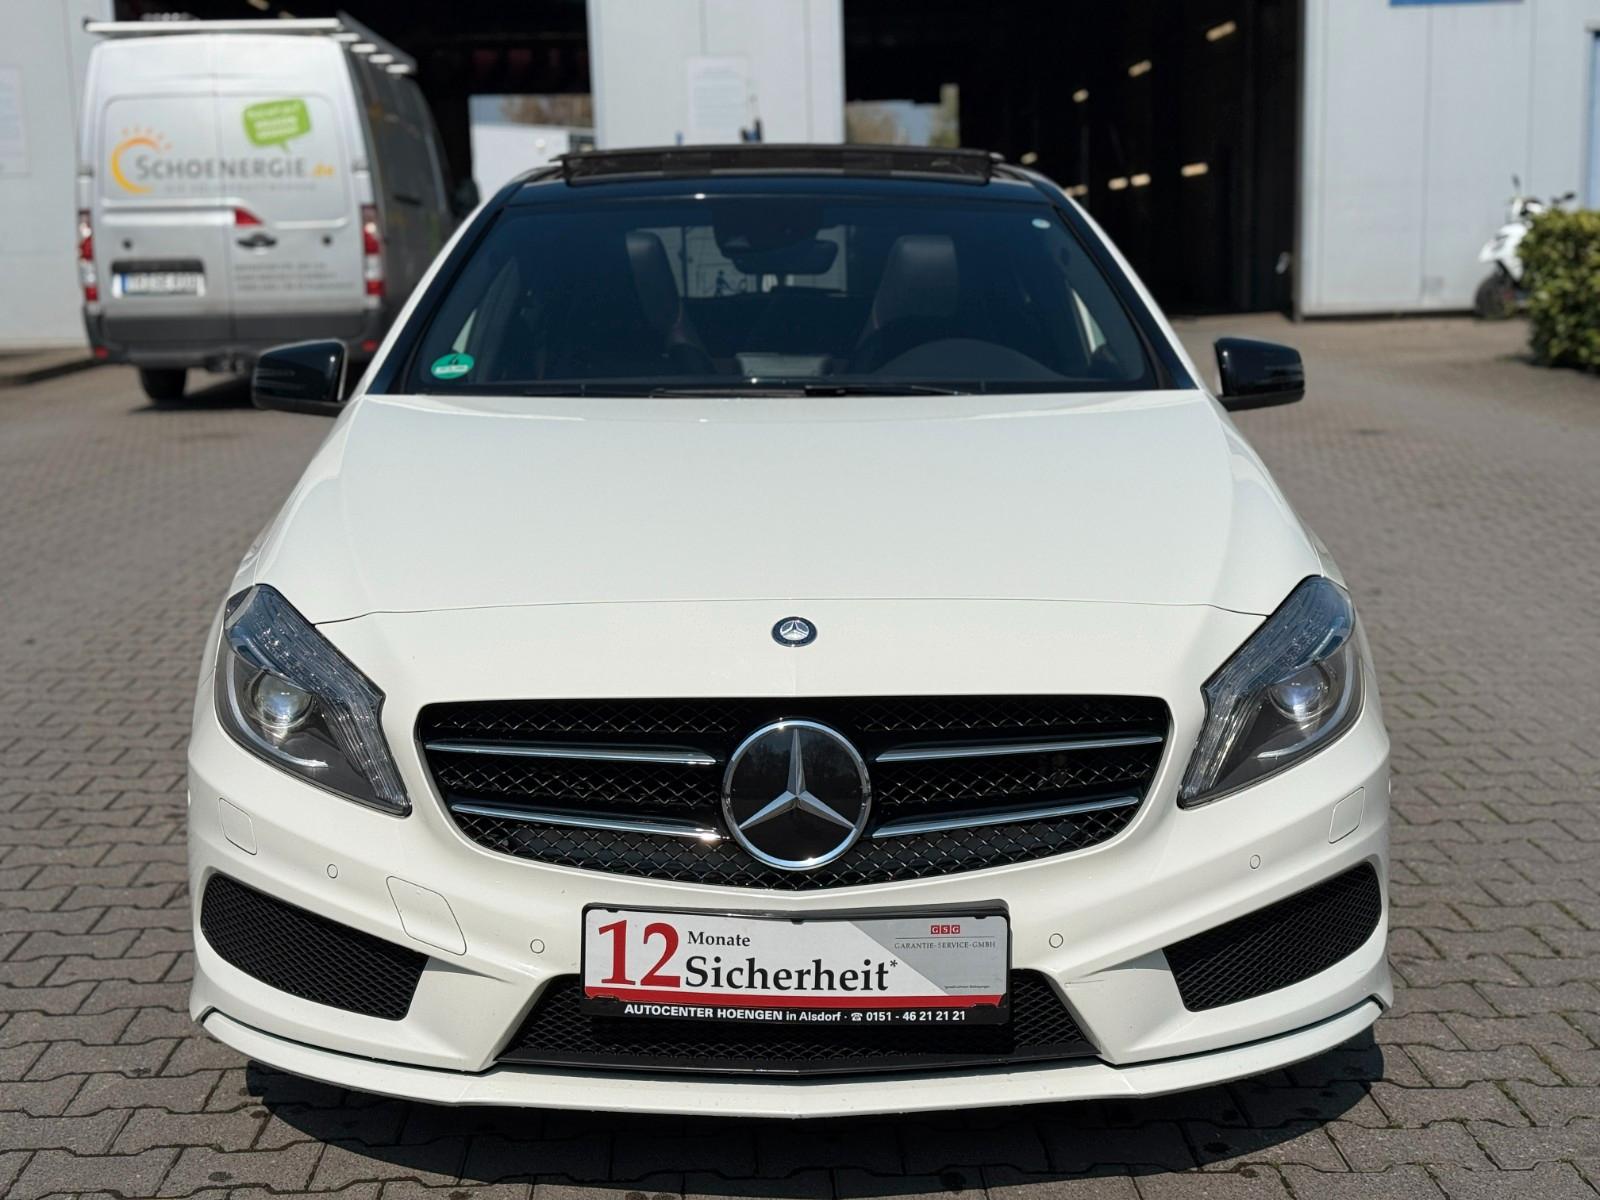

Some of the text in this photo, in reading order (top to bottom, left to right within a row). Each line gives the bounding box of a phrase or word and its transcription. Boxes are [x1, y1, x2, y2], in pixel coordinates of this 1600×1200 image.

[687, 930, 751, 947] Monate
[931, 925, 960, 934] GSG
[598, 920, 681, 988] 12
[624, 1003, 713, 1018] AUTOCENTER
[717, 1008, 783, 1021] HOENGEN
[786, 1010, 797, 1021] in
[799, 1011, 842, 1022] Alsdorf
[866, 1011, 892, 1021] 0151
[902, 1011, 917, 1021] 46
[920, 1011, 933, 1021] 21
[936, 1011, 949, 1021] 21
[952, 1010, 966, 1021] 21
